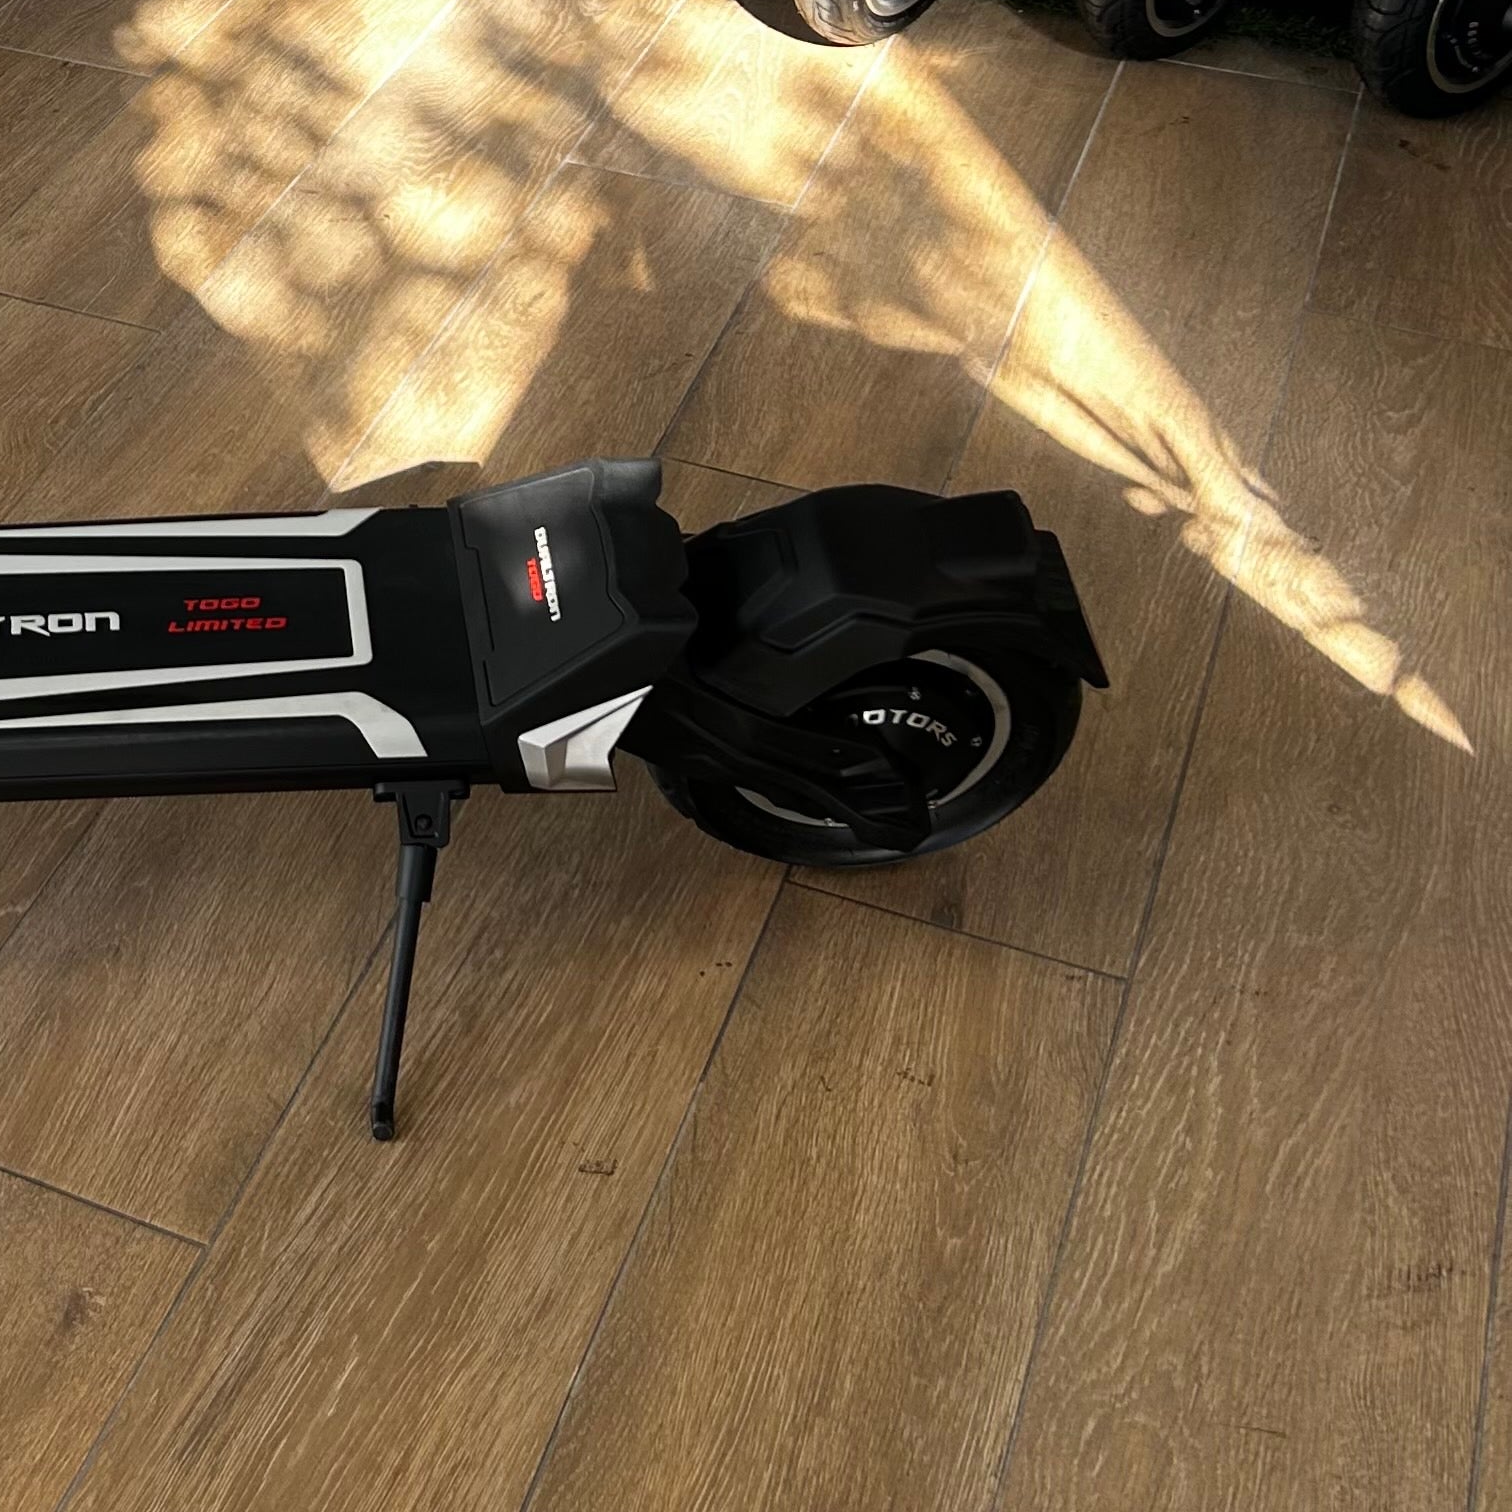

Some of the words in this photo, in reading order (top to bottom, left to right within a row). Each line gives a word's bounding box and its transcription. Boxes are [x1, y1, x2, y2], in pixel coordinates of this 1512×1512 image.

[526, 558, 543, 601] TOGO
[534, 526, 561, 622] DUALTRON
[184, 597, 262, 611] TOGO
[168, 616, 289, 633] LIMITED
[862, 708, 958, 747] OTORS
